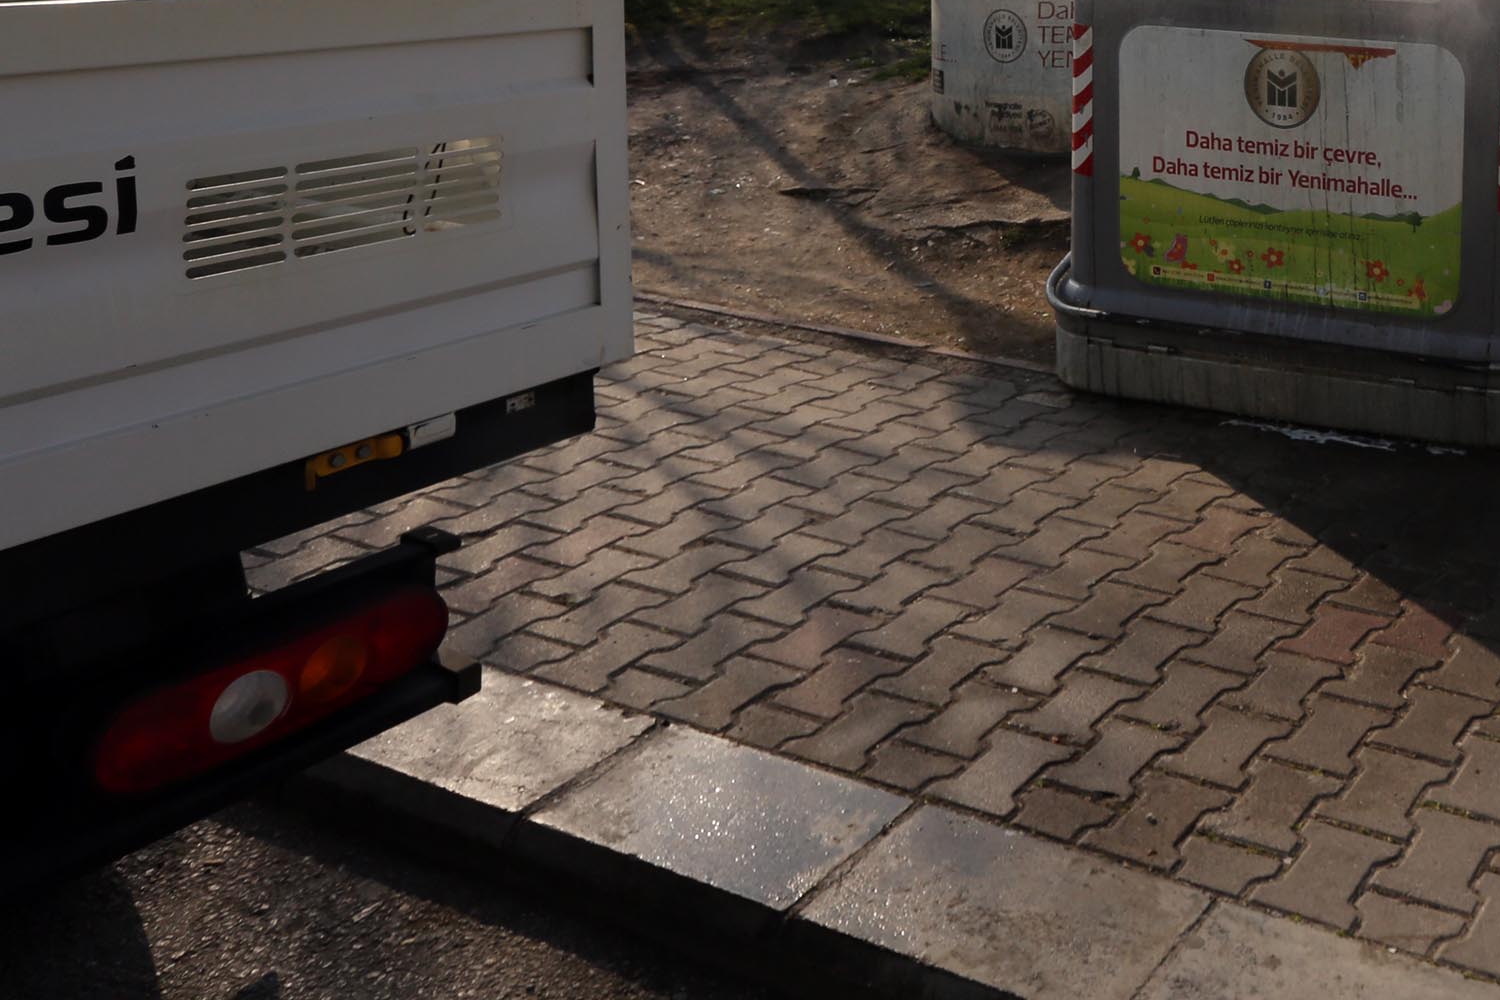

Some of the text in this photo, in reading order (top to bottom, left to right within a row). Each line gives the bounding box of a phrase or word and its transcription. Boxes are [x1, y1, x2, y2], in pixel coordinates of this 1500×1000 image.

[1186, 131, 1382, 168] Daha temiz bir çevre,
[1152, 156, 1418, 200] Daha temiz bir Yenimahalle...
[0, 155, 137, 255] esi
